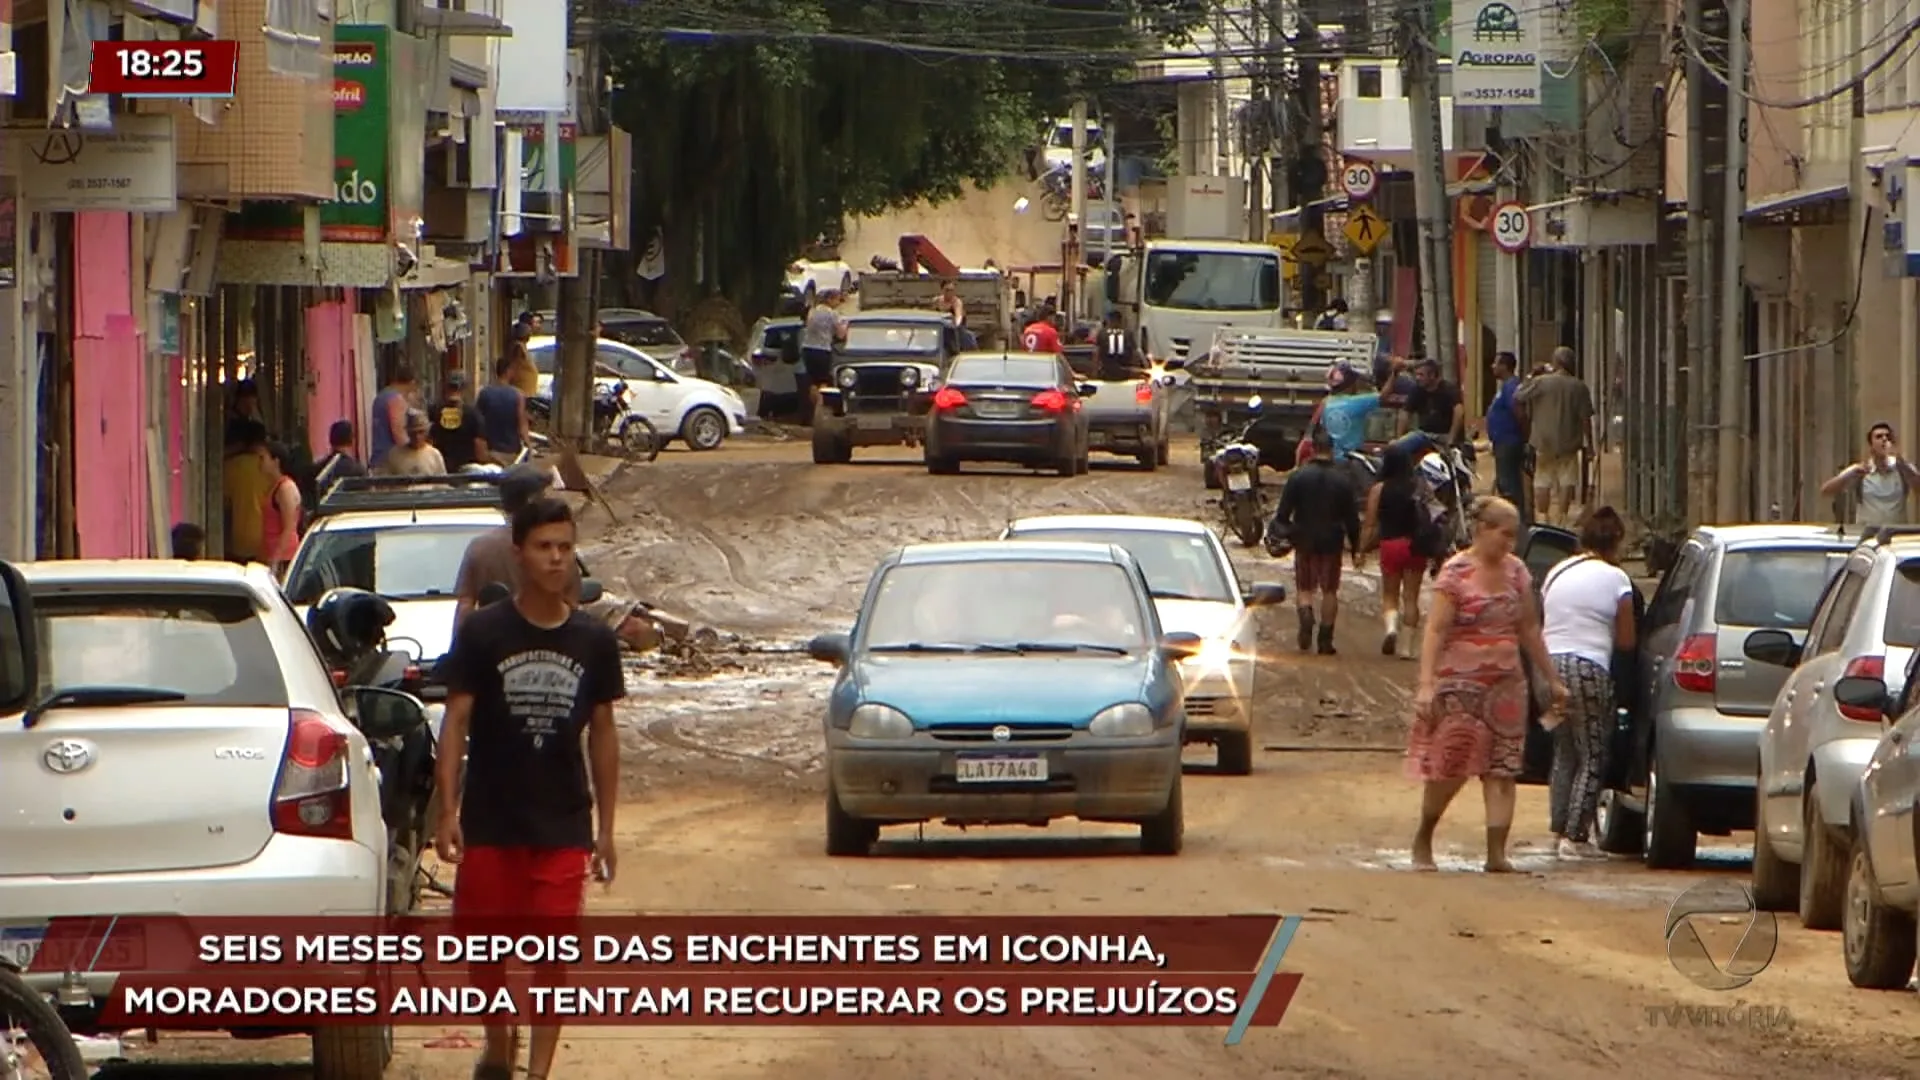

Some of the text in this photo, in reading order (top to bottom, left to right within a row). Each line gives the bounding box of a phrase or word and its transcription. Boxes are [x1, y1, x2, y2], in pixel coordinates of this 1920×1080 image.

[1457, 50, 1536, 66] AGROPAG
[332, 86, 361, 101] ofril
[1475, 87, 1536, 99] 3537-1548
[1347, 168, 1370, 186] 30
[1498, 212, 1525, 234] 30
[1108, 333, 1125, 355] 11
